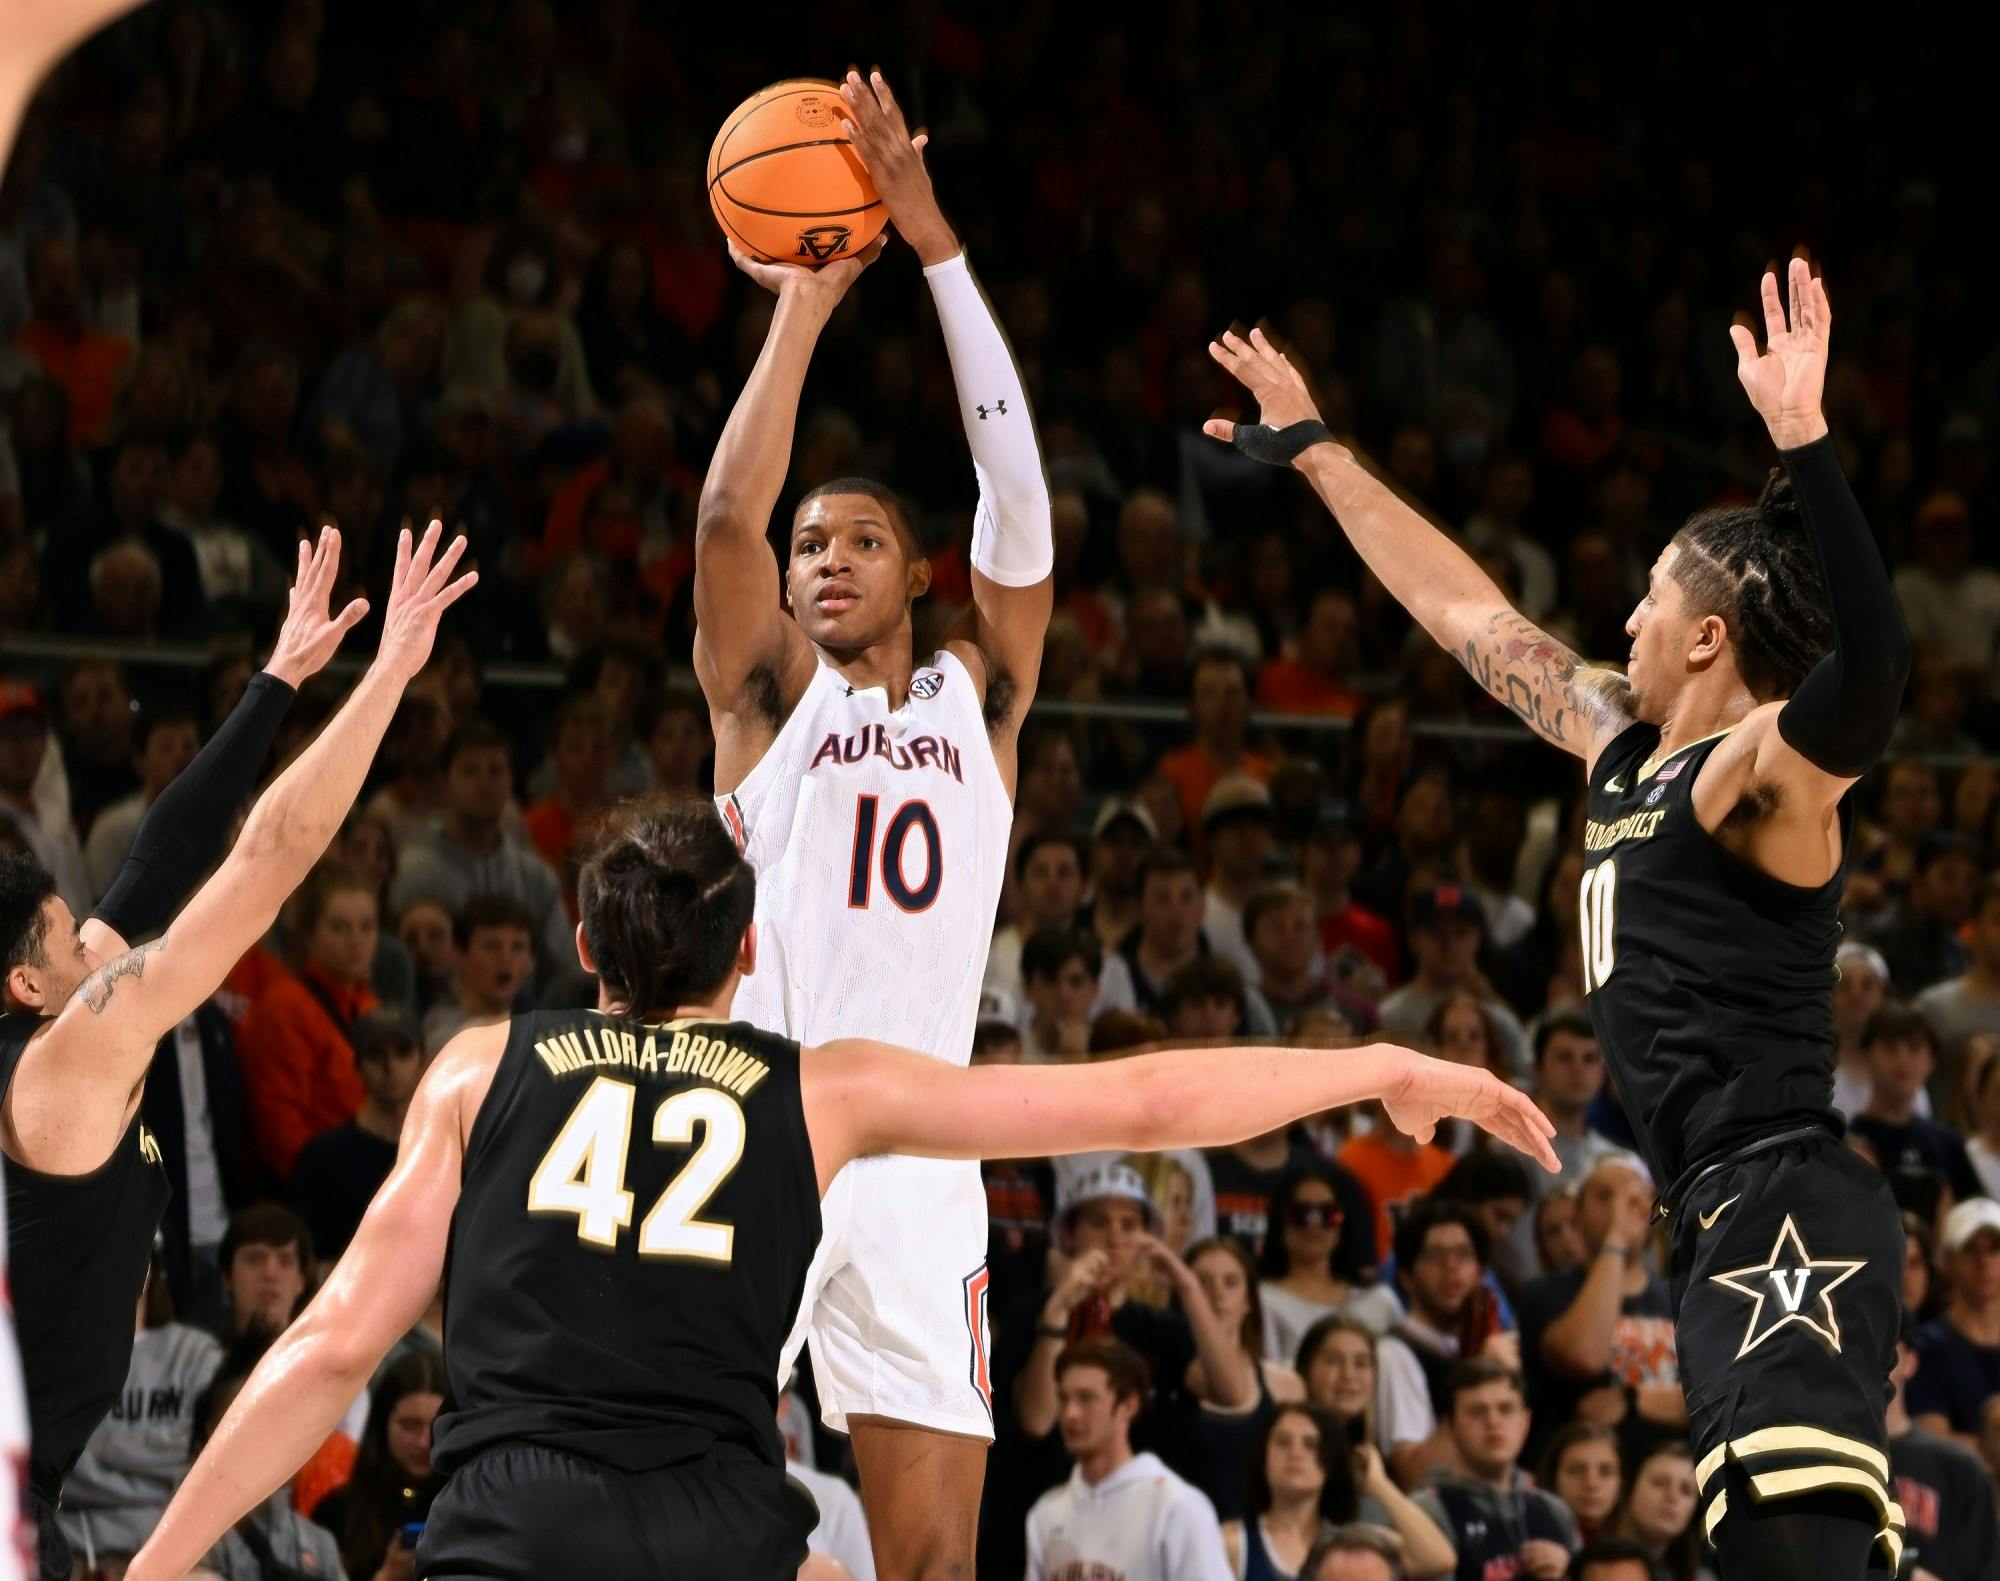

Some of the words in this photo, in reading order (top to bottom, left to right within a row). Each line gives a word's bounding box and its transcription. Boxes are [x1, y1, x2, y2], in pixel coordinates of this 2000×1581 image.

[848, 793, 943, 914] 10
[1580, 858, 1616, 998] 10
[534, 1028, 770, 1097] MILLORA-BROWN
[527, 1075, 746, 1261] 42
[1769, 1268, 1811, 1311] V
